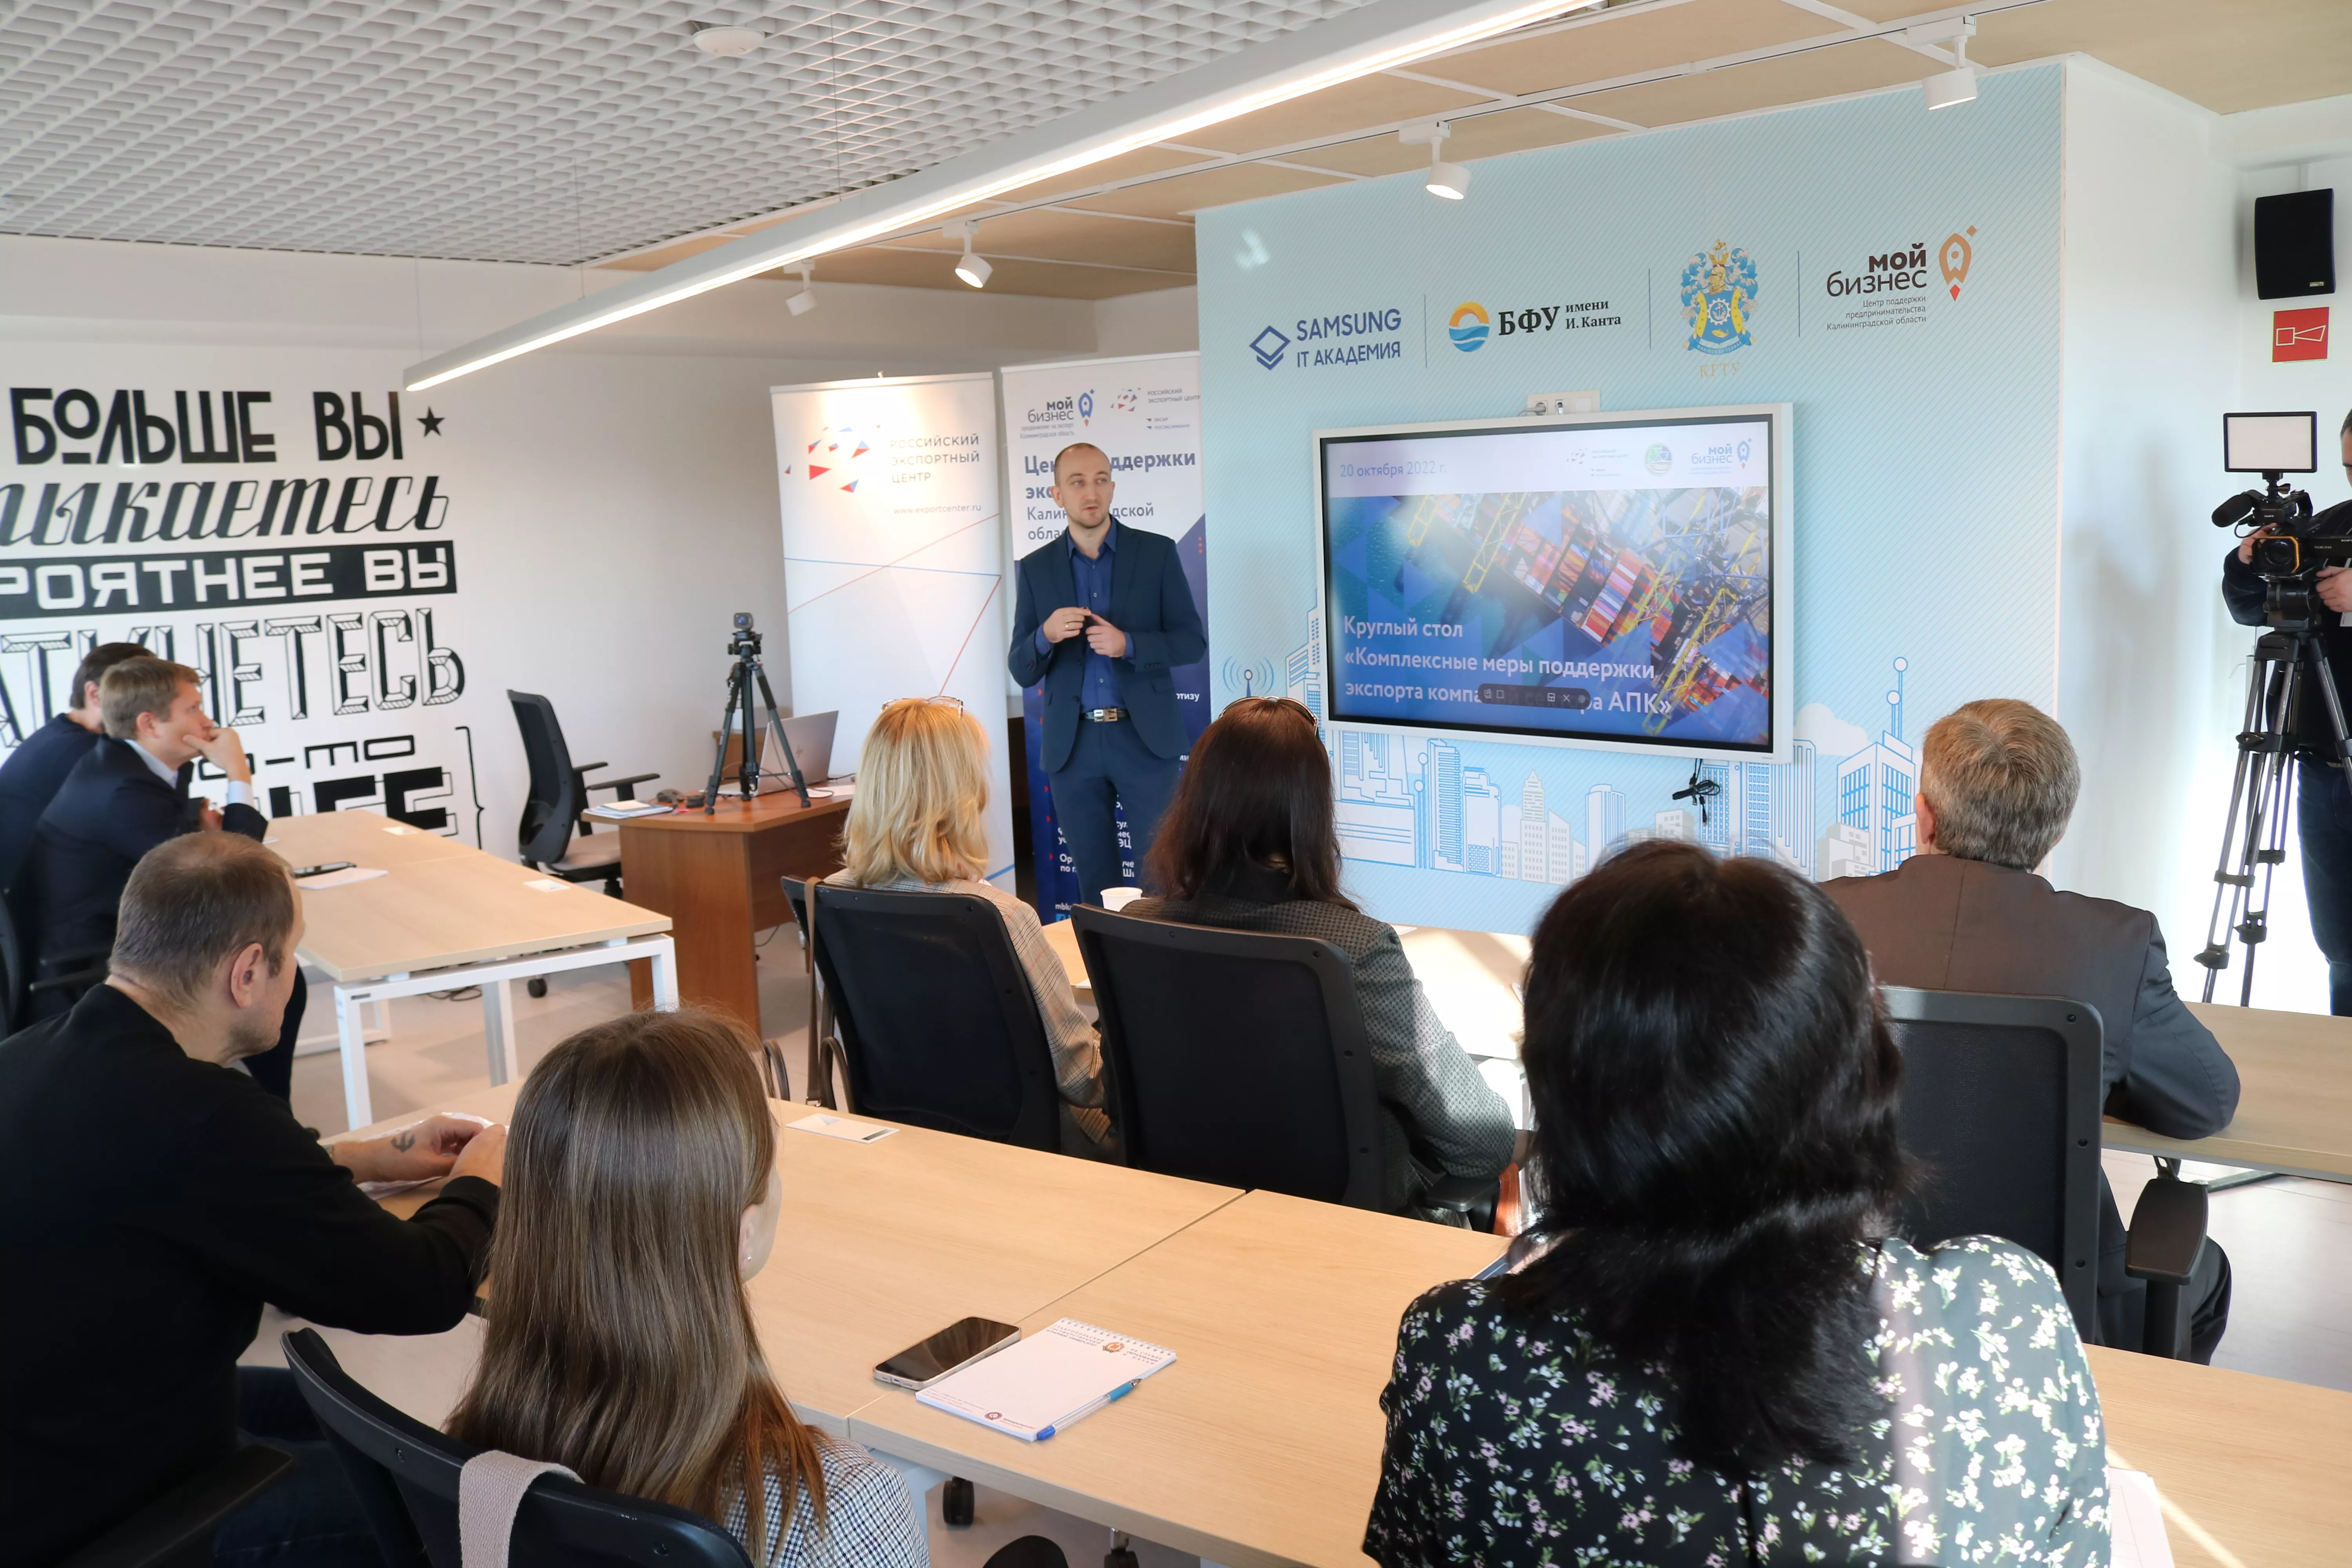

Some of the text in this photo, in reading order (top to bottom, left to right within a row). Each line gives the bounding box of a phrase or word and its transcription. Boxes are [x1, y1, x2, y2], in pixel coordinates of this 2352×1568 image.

[1869, 243, 1926, 272] мой
[1827, 270, 1927, 297] бизнес
[1566, 301, 1609, 313] имени
[1863, 296, 1926, 308] Центр поддержки
[1846, 306, 1926, 320] предпринимательства
[1297, 309, 1401, 341] SAMSUNG
[1498, 306, 1561, 336] БФУ
[1566, 316, 1621, 329] И. Канта
[1827, 316, 1927, 330] Калининградской области
[1314, 341, 1401, 366] АКАДЕМИЯ
[1700, 362, 1741, 378] КГТУ
[1047, 397, 1073, 410] мой
[1028, 409, 1074, 423] бизнес
[10, 388, 403, 465] БОЛЬШЕ ВЫ
[890, 433, 979, 448] РОССИЙСКИЙ
[1709, 443, 1732, 455] мой
[891, 451, 980, 466] ЭКСПОРТНЫЙ
[1111, 453, 1196, 472] ддержки
[1691, 453, 1733, 464] бизнес
[1341, 464, 1354, 477] 20
[1357, 463, 1403, 478] октября
[1407, 461, 1436, 474] 2022
[892, 472, 931, 484] ЦЕНТР
[894, 505, 982, 514] www.exportcenter.ru
[364, 548, 448, 592] ВЫ
[1344, 615, 1463, 639] Круглый стол
[1345, 647, 1655, 681] «Комплексные меры поддержки
[1345, 681, 1423, 702] экспорта
[1608, 693, 1672, 715] АПК»
